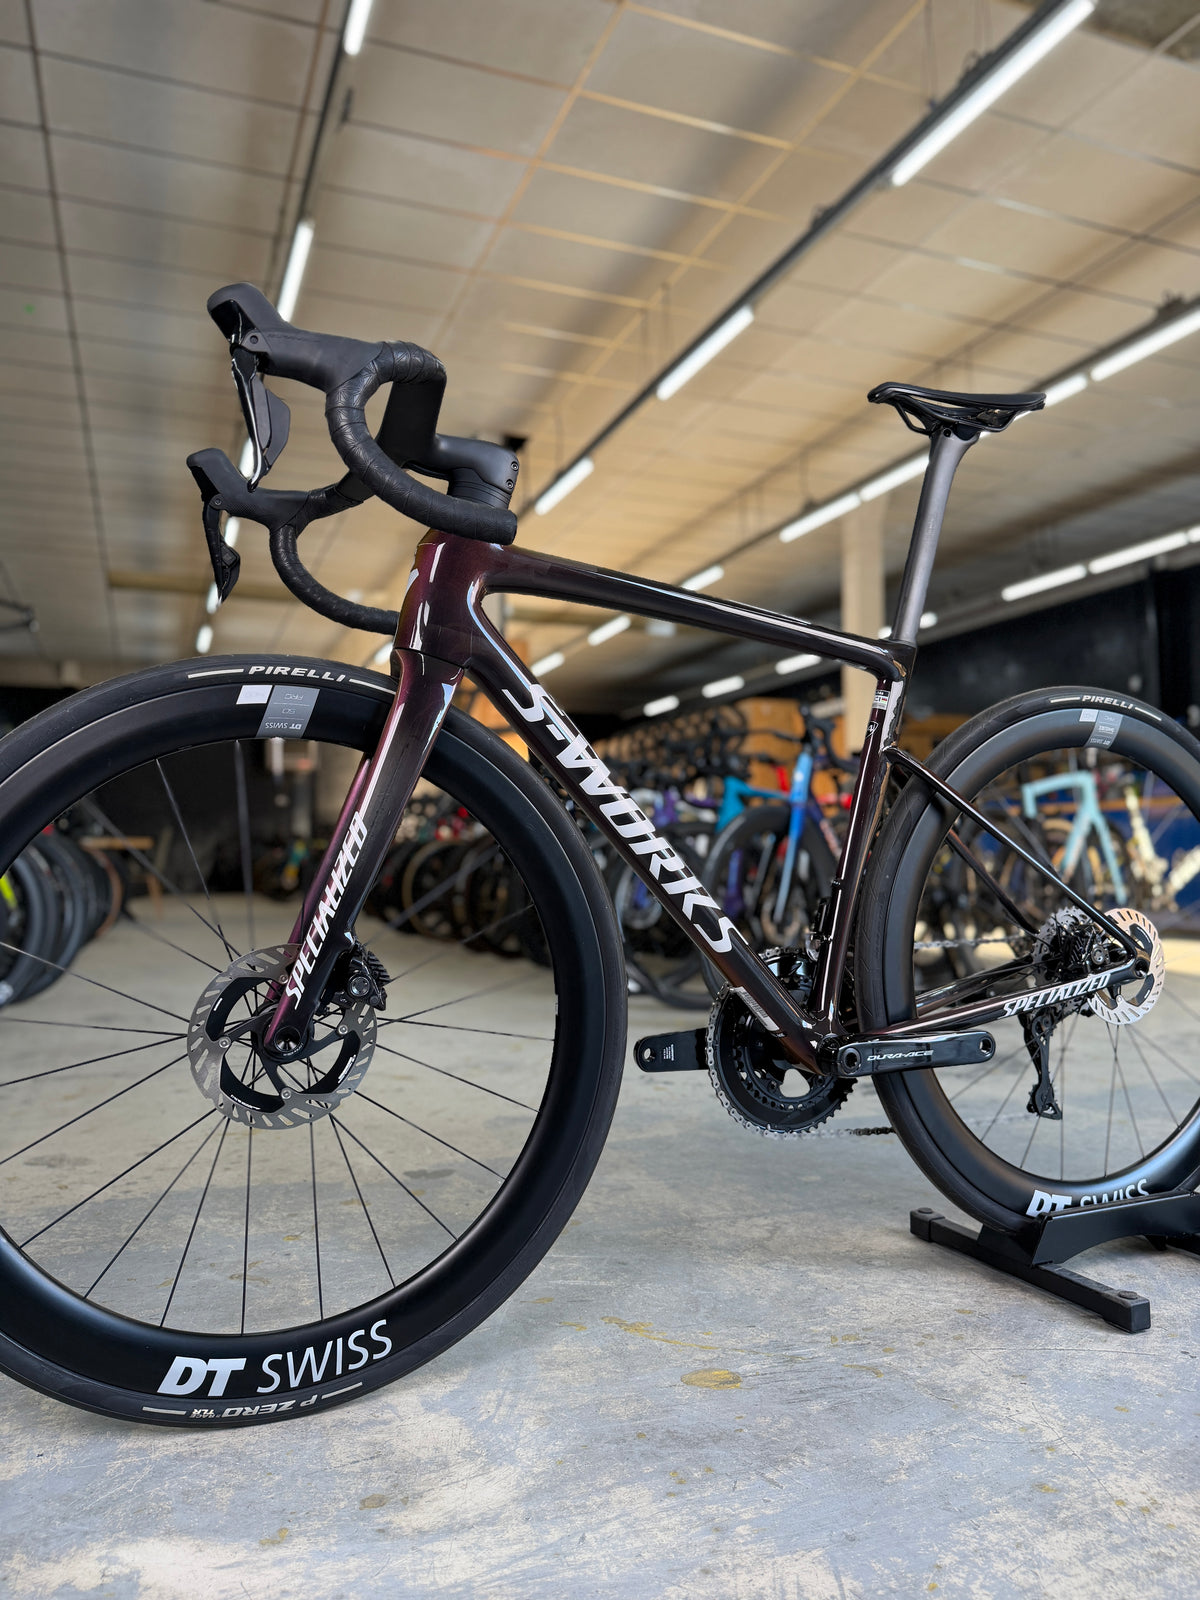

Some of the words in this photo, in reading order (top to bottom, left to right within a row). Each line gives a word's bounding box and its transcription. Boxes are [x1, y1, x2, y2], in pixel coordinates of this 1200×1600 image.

[249, 665, 345, 682] PIRELLI
[1082, 695, 1133, 709] PIRELLI
[265, 722, 288, 730] SWISS
[502, 684, 749, 953] S-WORKS
[286, 811, 368, 1010] SPECIALIZED
[999, 973, 1111, 1019] SPECIALIZED
[867, 1049, 934, 1062] DURA-ACE
[157, 1355, 247, 1397] DT
[256, 1319, 393, 1393] SWISS
[222, 1400, 296, 1418] ZERO
[300, 1395, 318, 1407] P
